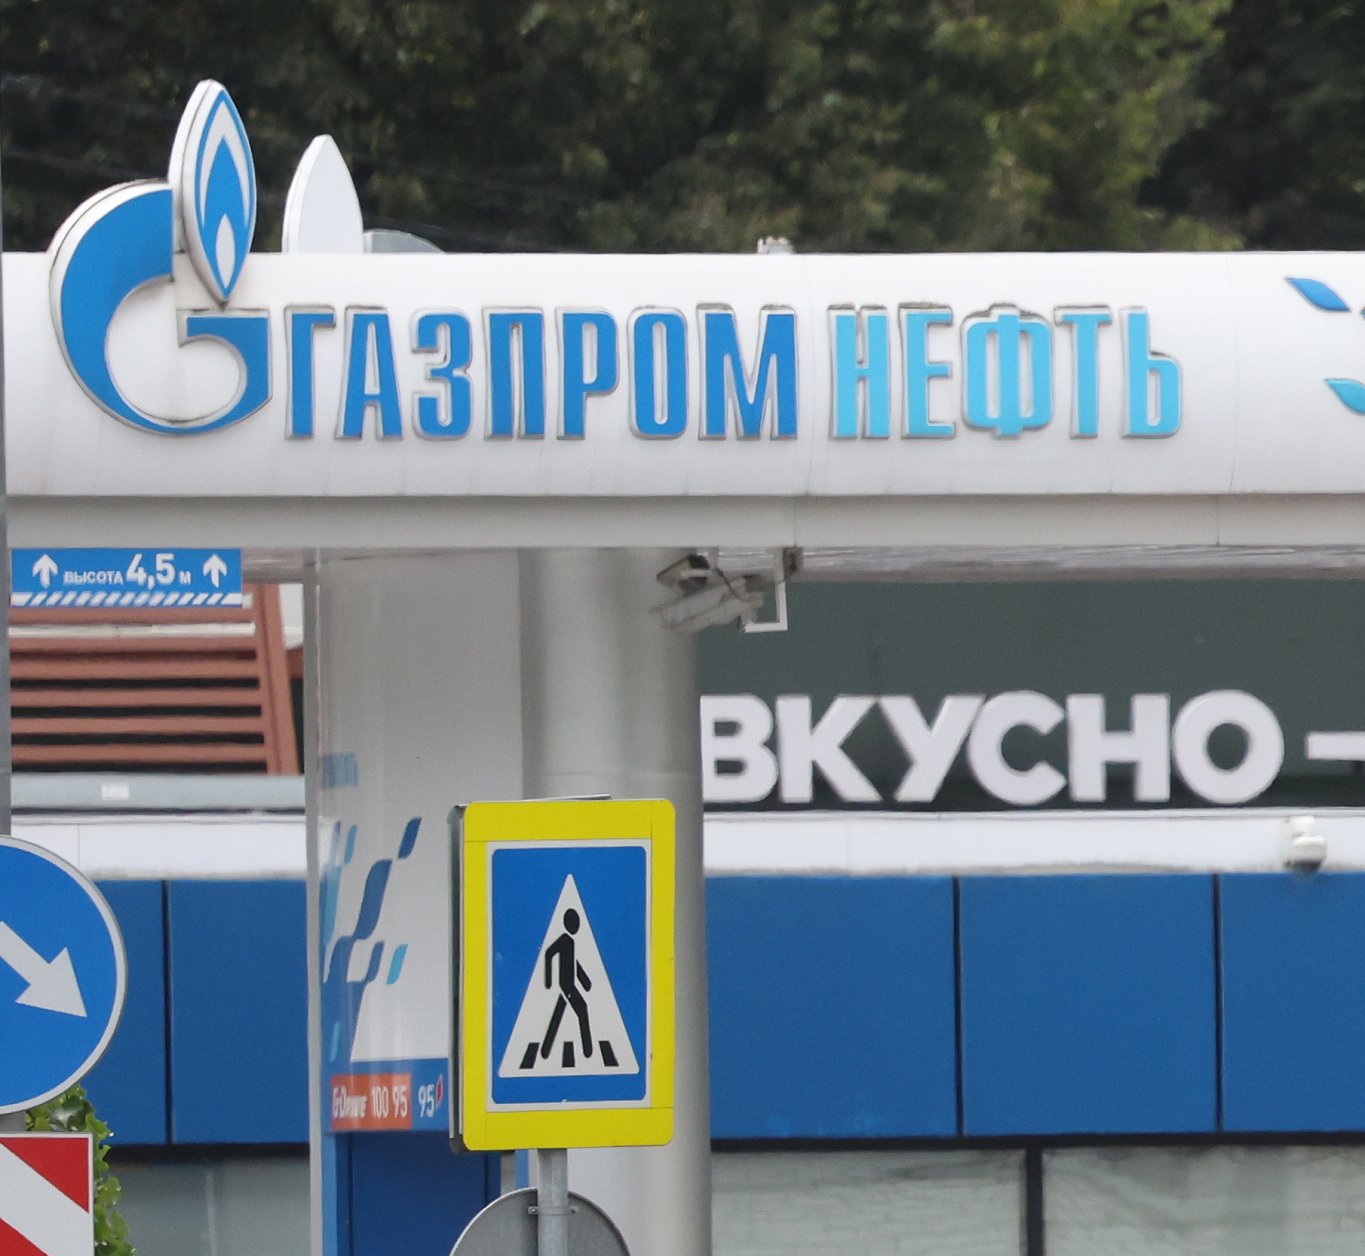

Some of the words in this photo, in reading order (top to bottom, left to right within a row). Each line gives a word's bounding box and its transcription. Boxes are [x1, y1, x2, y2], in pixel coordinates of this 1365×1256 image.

[284, 304, 799, 441] ГАЗПРОМ
[829, 302, 1183, 440] НЕФТЬ
[63, 570, 124, 586] ВЫСОТА
[125, 553, 175, 591] 4,5
[700, 689, 1285, 805] ВКУСНО
[371, 1086, 390, 1119] 100
[392, 1085, 409, 1119] 95
[418, 1083, 435, 1118] 95
